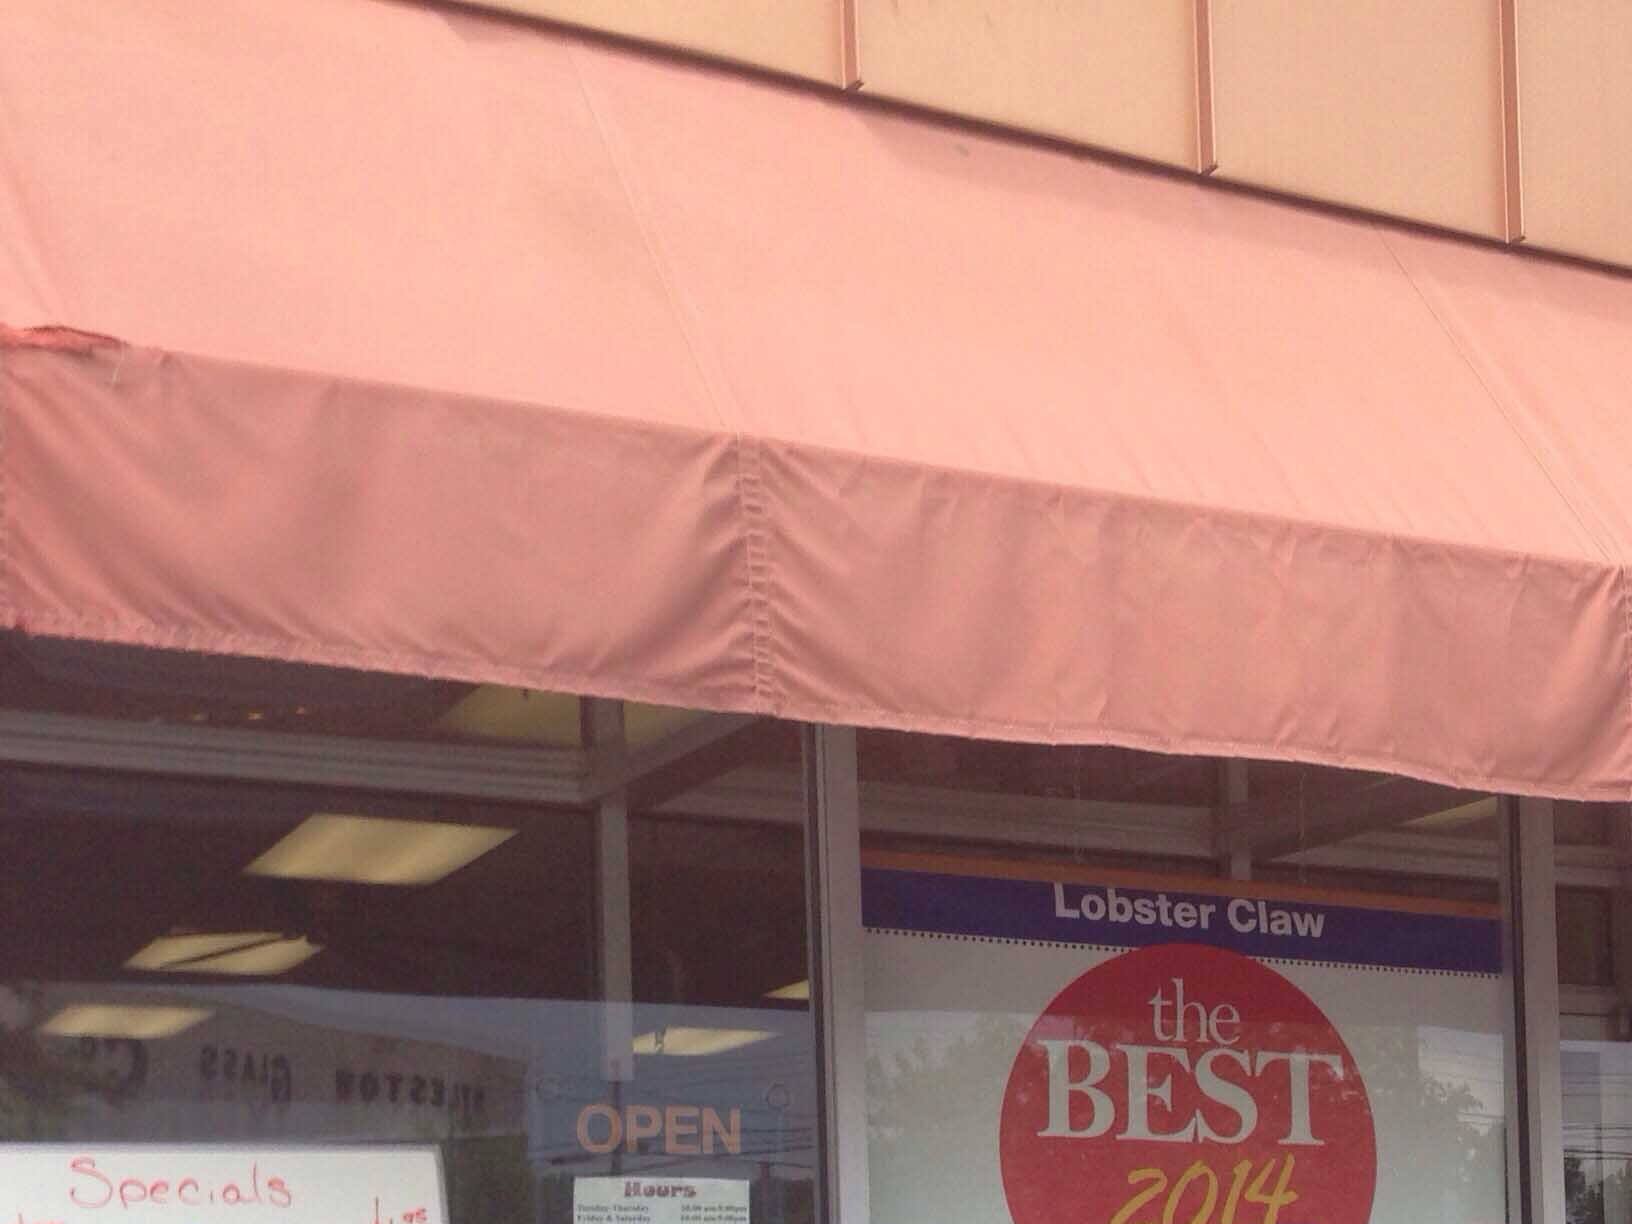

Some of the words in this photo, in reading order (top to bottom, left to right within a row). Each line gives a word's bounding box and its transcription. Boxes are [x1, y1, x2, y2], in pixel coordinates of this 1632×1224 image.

[1053, 882, 1216, 930] Lobster
[1227, 898, 1326, 938] Claw
[1148, 977, 1241, 1045] the
[1036, 1039, 1343, 1147] BEST
[576, 1103, 741, 1154] OPEN
[69, 1156, 292, 1209] Specials
[624, 1181, 697, 1198] Hours
